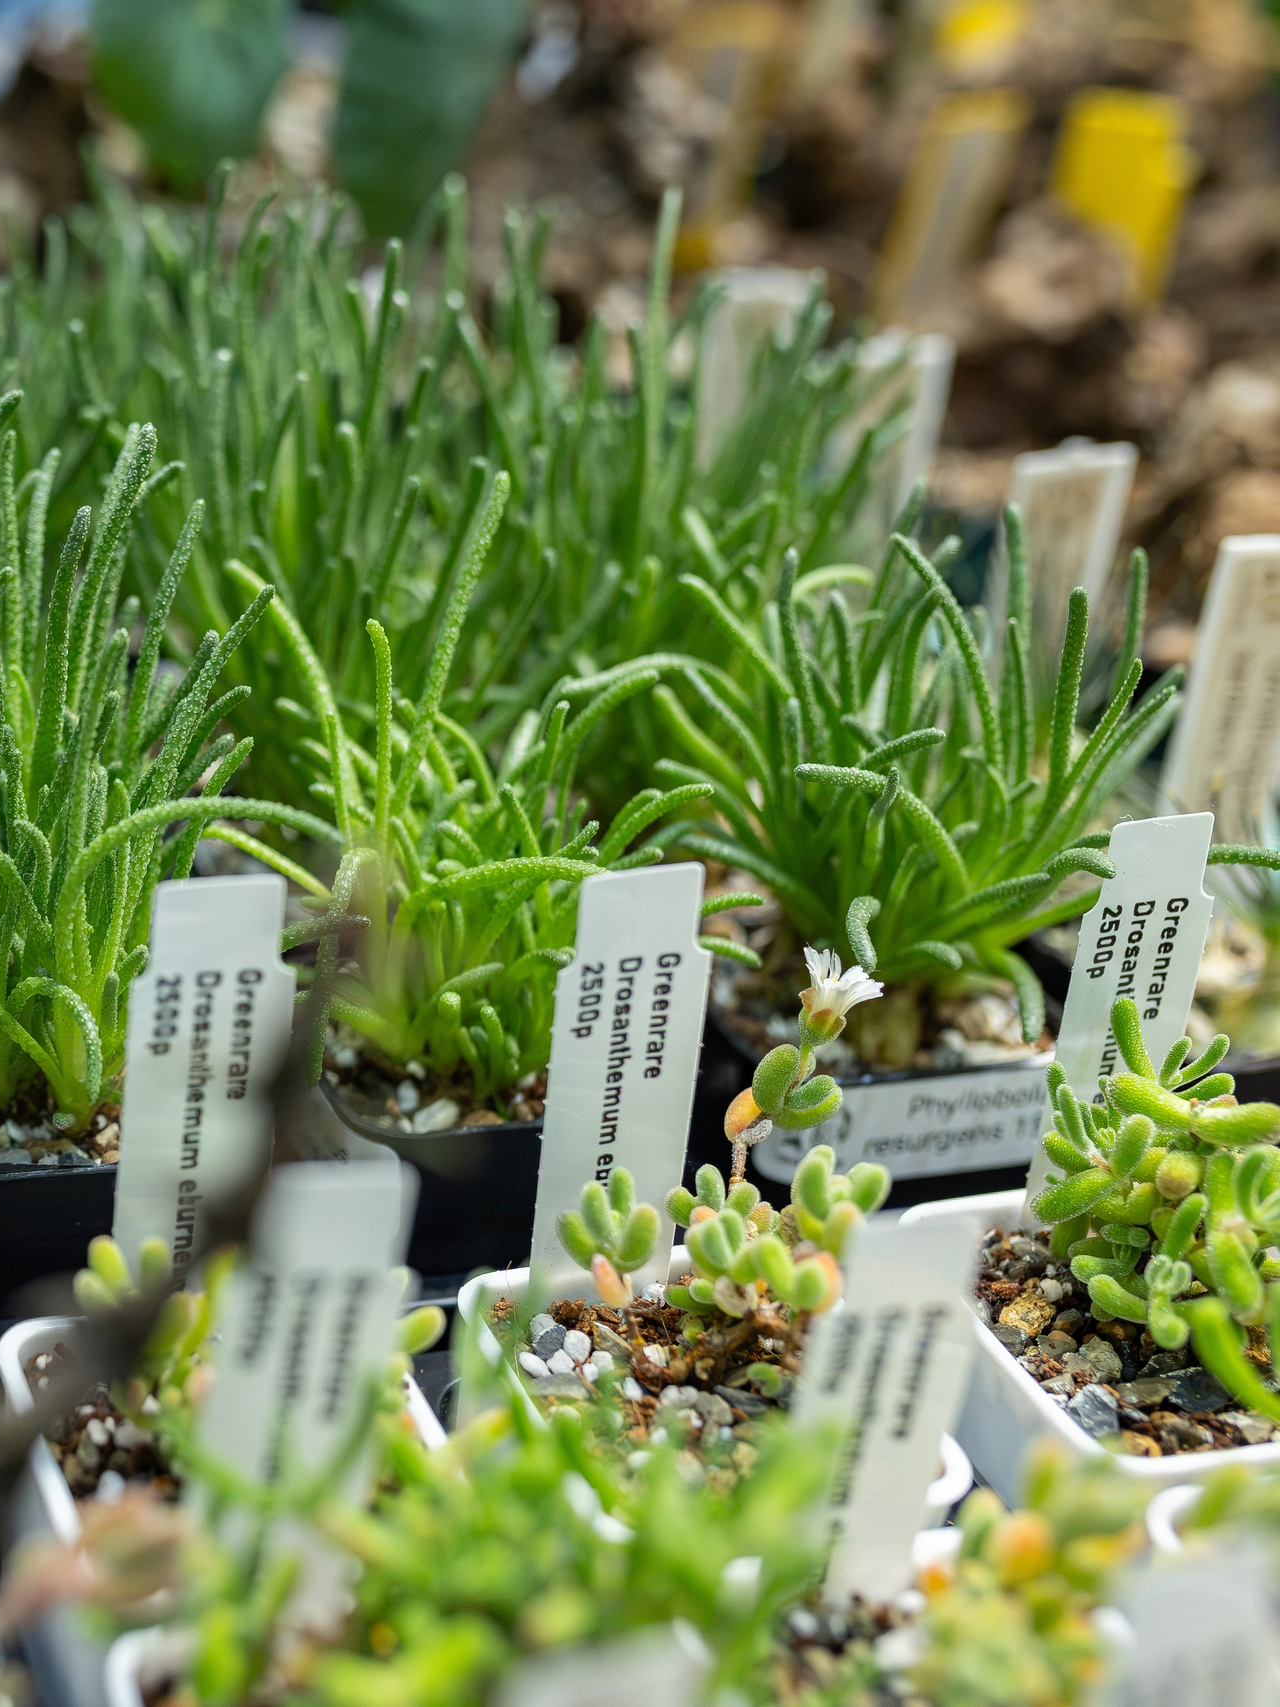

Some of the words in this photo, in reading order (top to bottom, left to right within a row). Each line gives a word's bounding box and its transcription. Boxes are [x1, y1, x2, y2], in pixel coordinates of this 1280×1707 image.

[571, 962, 604, 1039] 2500p
[1086, 905, 1122, 979] 2500p
[1096, 900, 1156, 1078] Drosantmum
[1144, 897, 1189, 1020] Greenrare
[148, 972, 181, 1057] 2500p
[227, 968, 265, 1101] Greenrare
[598, 956, 642, 1146] Drosanthemum
[643, 952, 681, 1079] Greenrare
